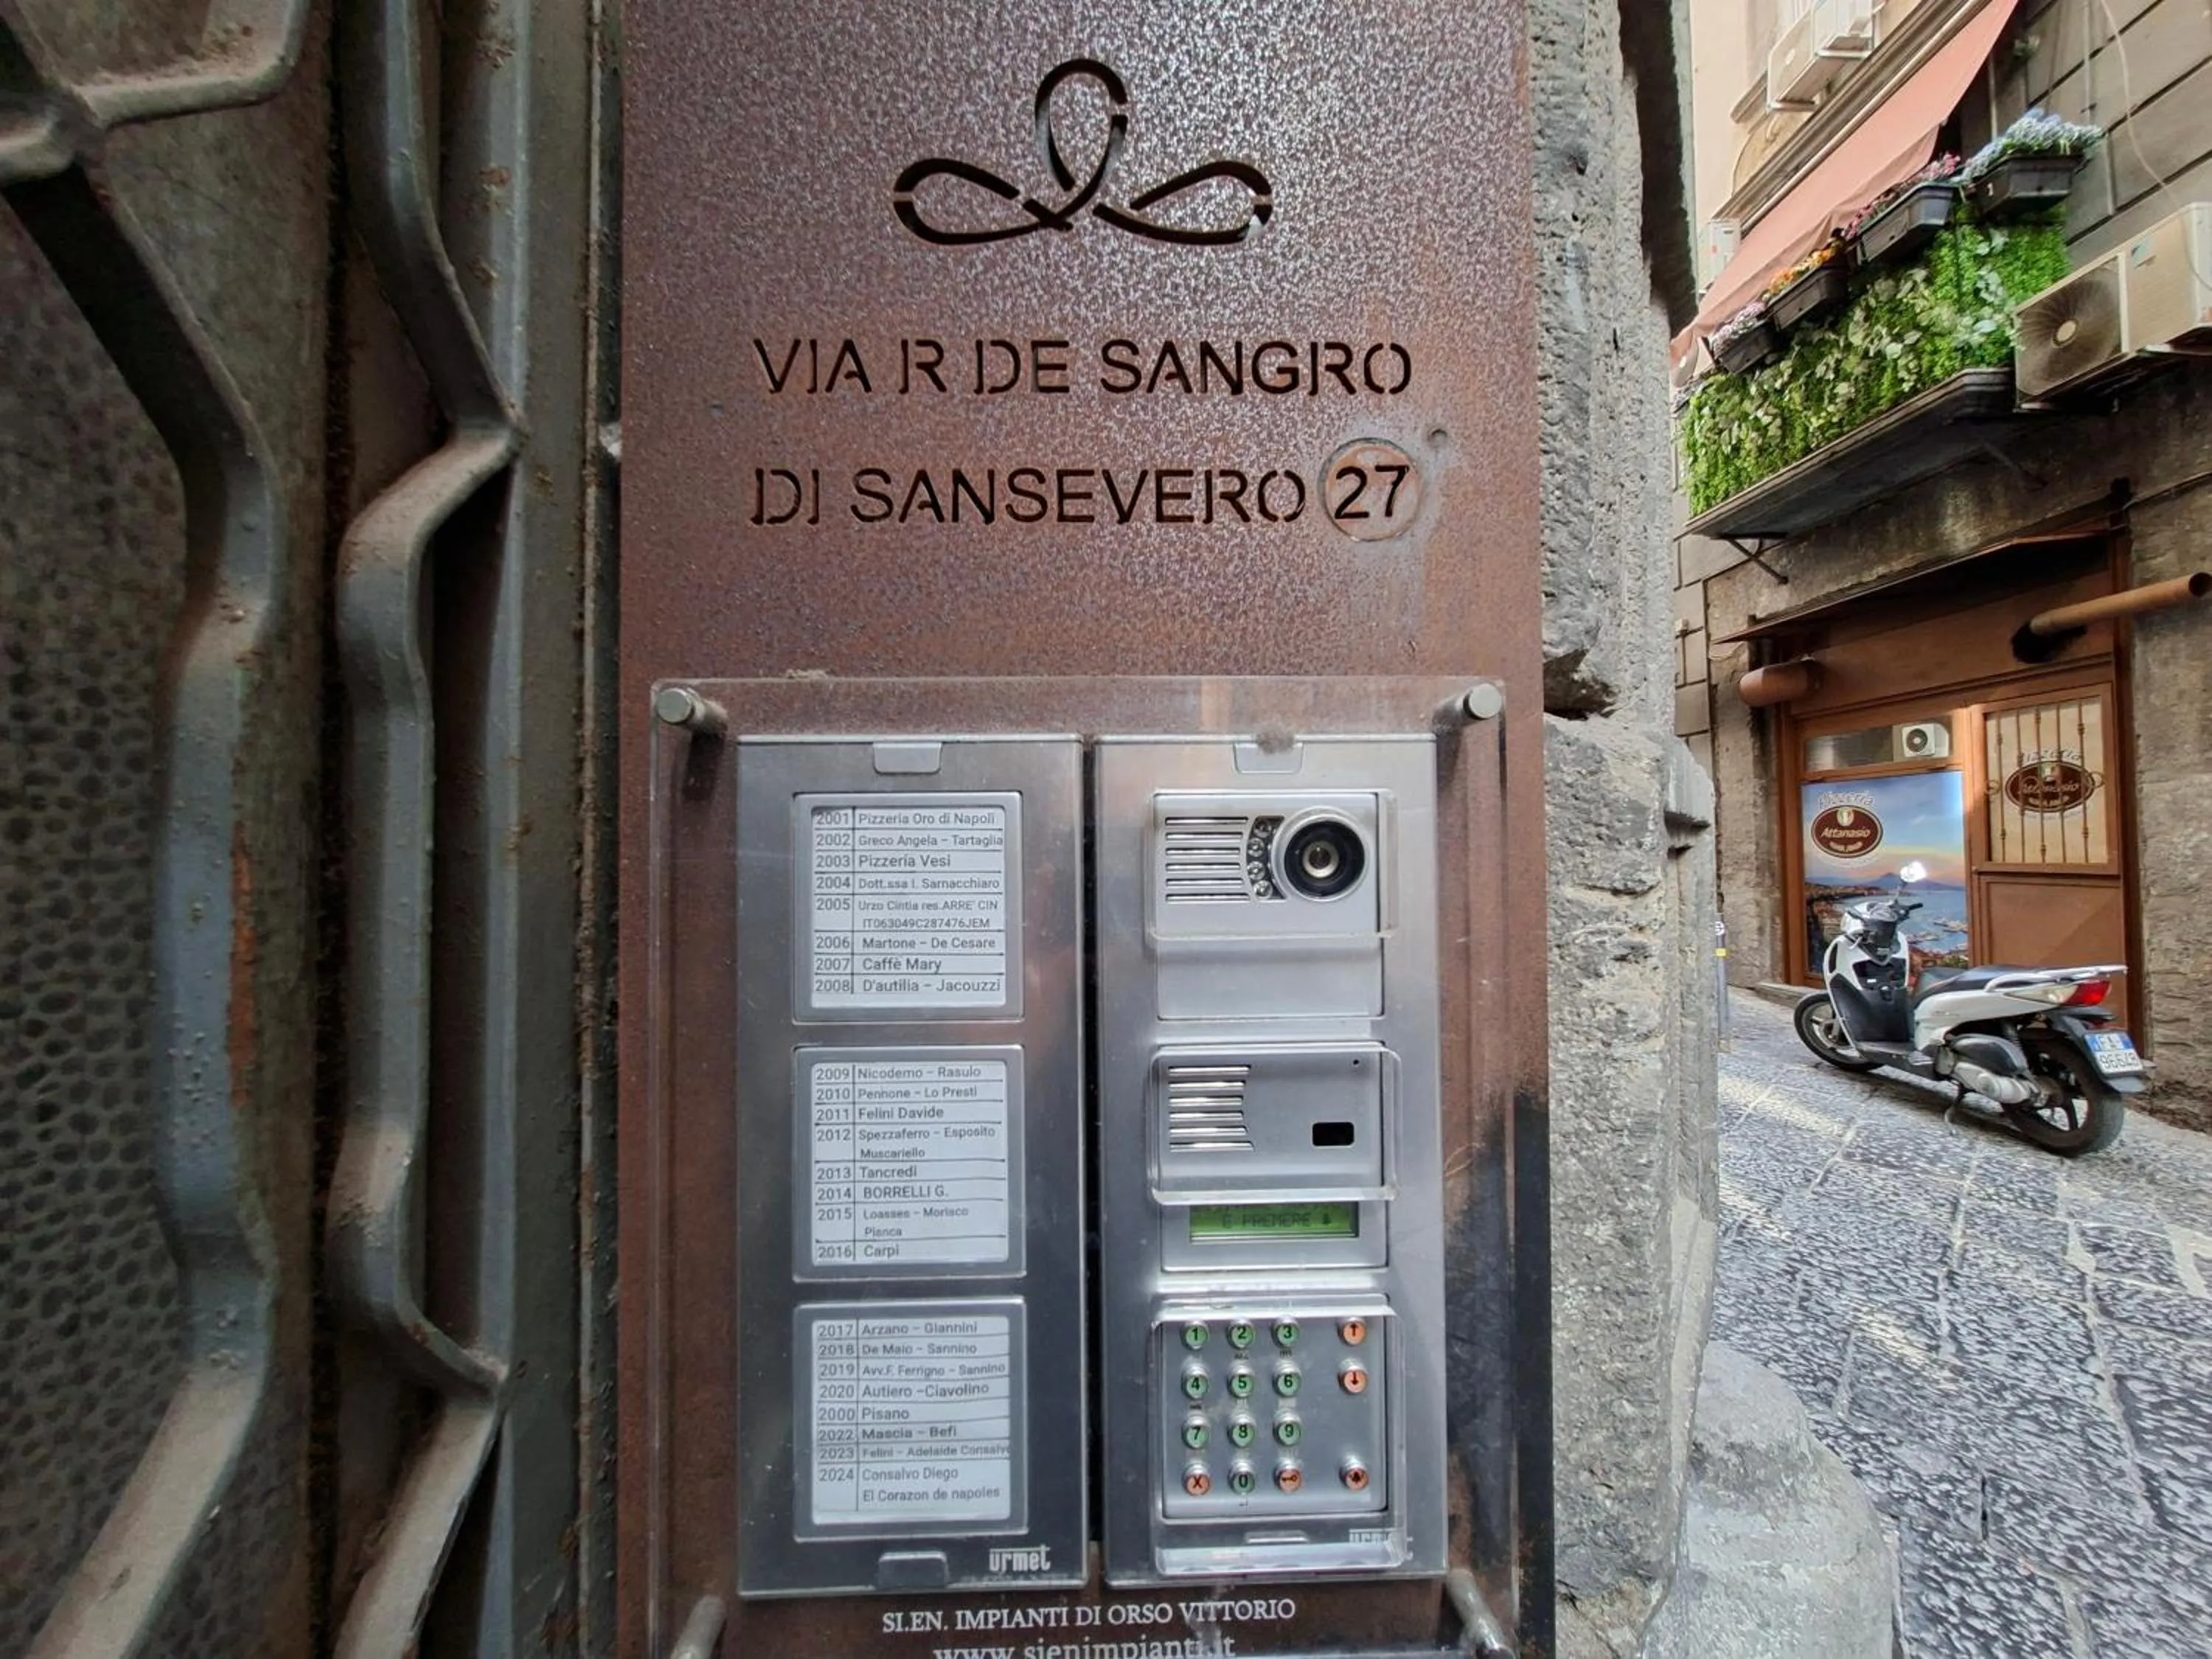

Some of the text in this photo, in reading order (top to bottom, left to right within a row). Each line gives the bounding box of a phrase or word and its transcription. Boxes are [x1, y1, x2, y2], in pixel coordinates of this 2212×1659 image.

[753, 339, 1411, 394] VIA R DE SANGRO
[752, 464, 1410, 524] DI SANSEVERO 27
[816, 813, 995, 827] 2001 Pizzeria Oro di Napoli
[816, 834, 850, 846] 2002
[859, 835, 894, 846] Greco
[897, 835, 938, 847] Angela
[952, 835, 1003, 847] Tartaglia
[816, 855, 950, 867] 2003 Pizzeria Vesi
[816, 877, 850, 888] 2004
[816, 899, 850, 911] 2005
[978, 900, 998, 910] CIN
[816, 937, 850, 948] 2006
[863, 937, 916, 948] Martone
[931, 937, 947, 948] De
[951, 937, 995, 947] Cesare
[816, 958, 942, 973] 2007 Caffè Mary
[815, 980, 851, 991] 2008
[936, 979, 1001, 991] Jacouzzi
[816, 1068, 850, 1080] 2009
[858, 1067, 922, 1079] Nicodemo
[817, 1088, 850, 1100] 2010
[858, 1088, 911, 1099] Pennone
[925, 1088, 938, 1097] Lo
[942, 1086, 977, 1097] Presti
[816, 1107, 944, 1121] 2011 Felini Davide
[817, 1130, 850, 1141] 2012
[859, 1128, 930, 1141] Spezzaferro
[944, 1127, 995, 1140] Esposito
[817, 1166, 917, 1179] 2013 Tancredi
[818, 1189, 851, 1200] 2014
[863, 1186, 931, 1199] BORRELLI
[818, 1208, 852, 1220] 2015
[818, 1245, 900, 1258] 2016 Carpi
[819, 1325, 853, 1338] 2017
[861, 1324, 908, 1335] Arzano
[1192, 1327, 1199, 1340] 1
[1237, 1326, 1247, 1340] 2
[1283, 1325, 1292, 1339] 3
[819, 1345, 855, 1355] 2018
[863, 1345, 878, 1355] De
[928, 1343, 977, 1354] Sannino
[820, 1364, 855, 1376] 2019
[898, 1366, 945, 1378] Ferrigno
[959, 1363, 1005, 1374] Sannino
[1192, 1377, 1200, 1390] 4
[1238, 1375, 1247, 1388] 5
[1284, 1374, 1293, 1388] 6
[820, 1385, 854, 1398] 2020
[862, 1385, 912, 1398] Autiero
[819, 1408, 909, 1420] 2000 Pisano
[819, 1429, 854, 1441] 2022
[863, 1428, 912, 1439] Mascia
[1192, 1426, 1201, 1440] 7
[1239, 1425, 1248, 1438] 8
[1285, 1424, 1293, 1437] 9
[820, 1447, 854, 1458] 2023
[819, 1467, 958, 1482] 2024 Consalvo Diego
[1238, 1475, 1248, 1487] 0
[863, 1486, 1000, 1502] El Corazon de napoles
[989, 1543, 1051, 1573] urmet
[955, 1607, 1068, 1630] IMPIANTI
[1076, 1605, 1102, 1626] DI
[1107, 1603, 1173, 1624] ORSO
[1178, 1599, 1295, 1622] VITTORIO
